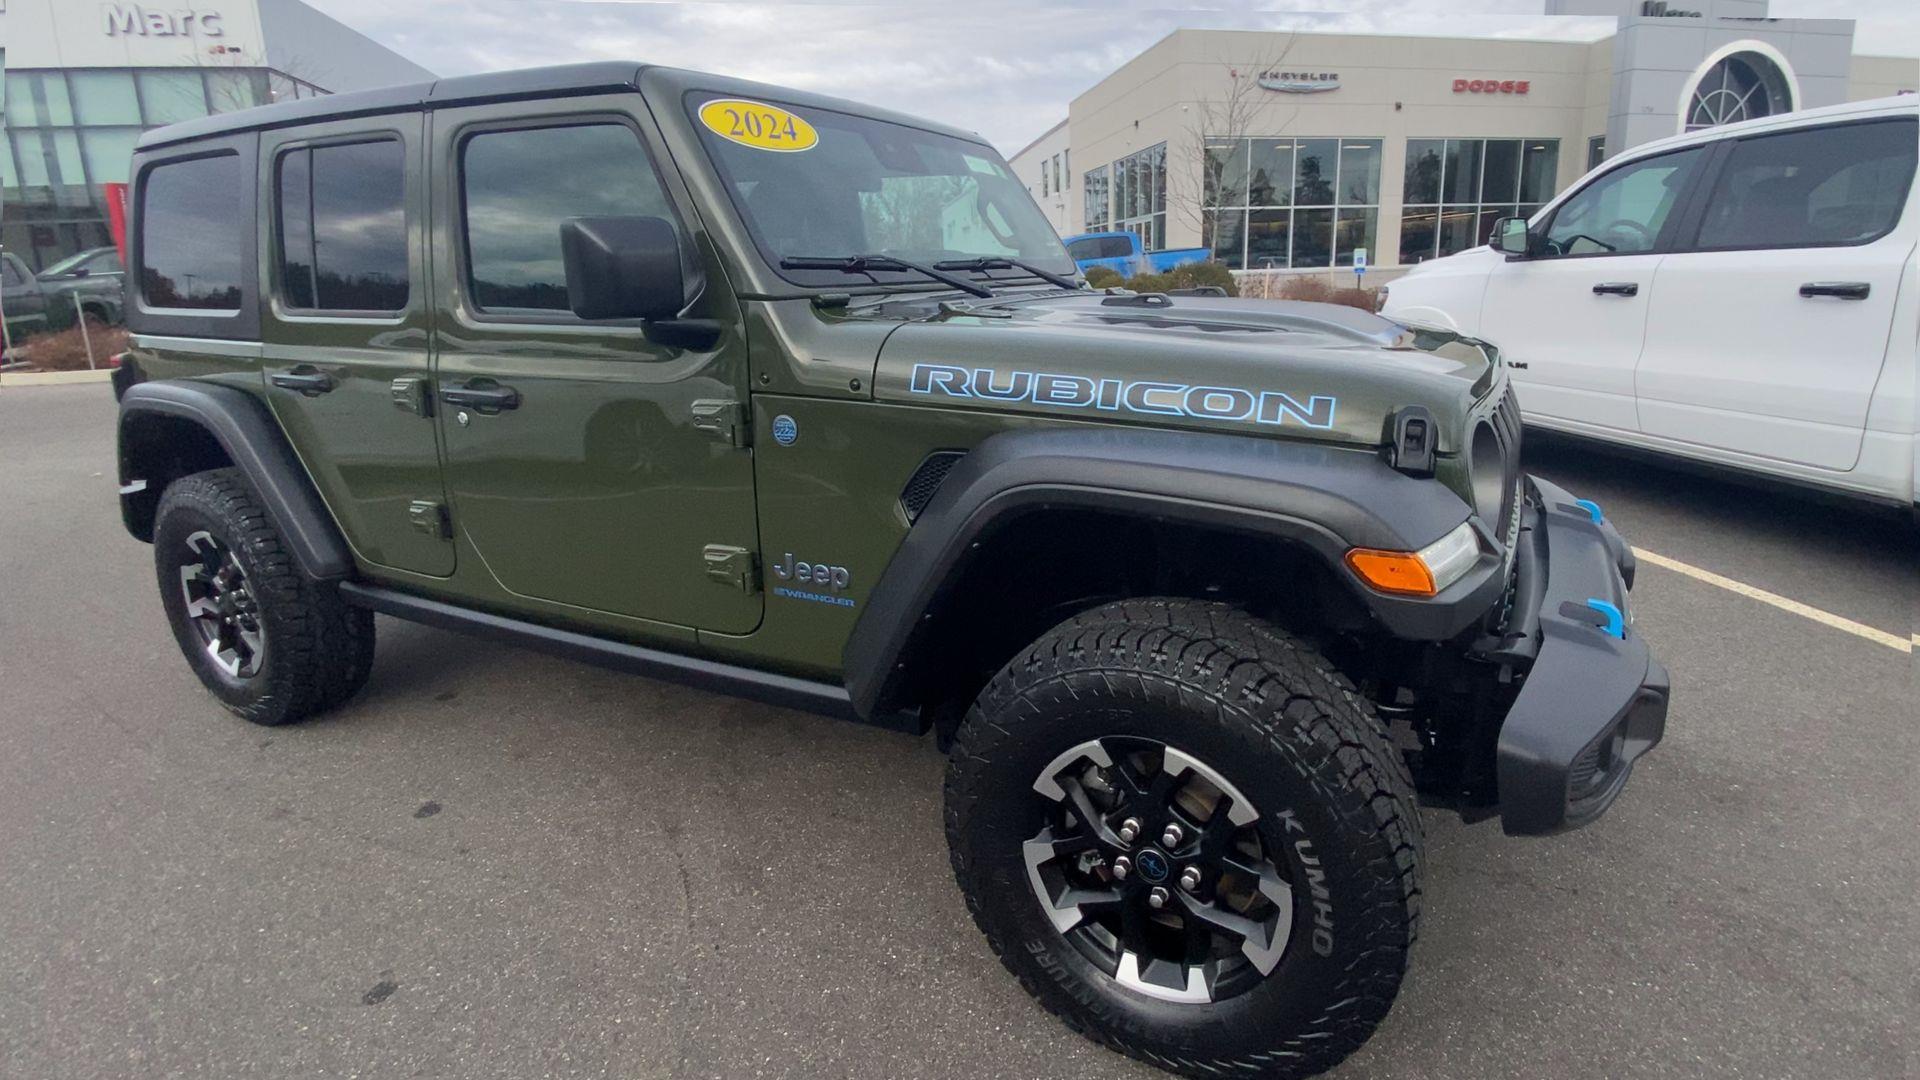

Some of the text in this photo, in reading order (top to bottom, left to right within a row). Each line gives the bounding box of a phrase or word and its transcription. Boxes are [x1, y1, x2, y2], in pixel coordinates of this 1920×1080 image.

[102, 3, 223, 37] Marc
[1259, 72, 1339, 80] CHRYSLER
[1452, 79, 1530, 94] DODGE
[725, 109, 796, 140] 2024
[910, 363, 1337, 429] RUBICON
[773, 553, 849, 592] Jeep
[1276, 808, 1334, 958] KUMHO
